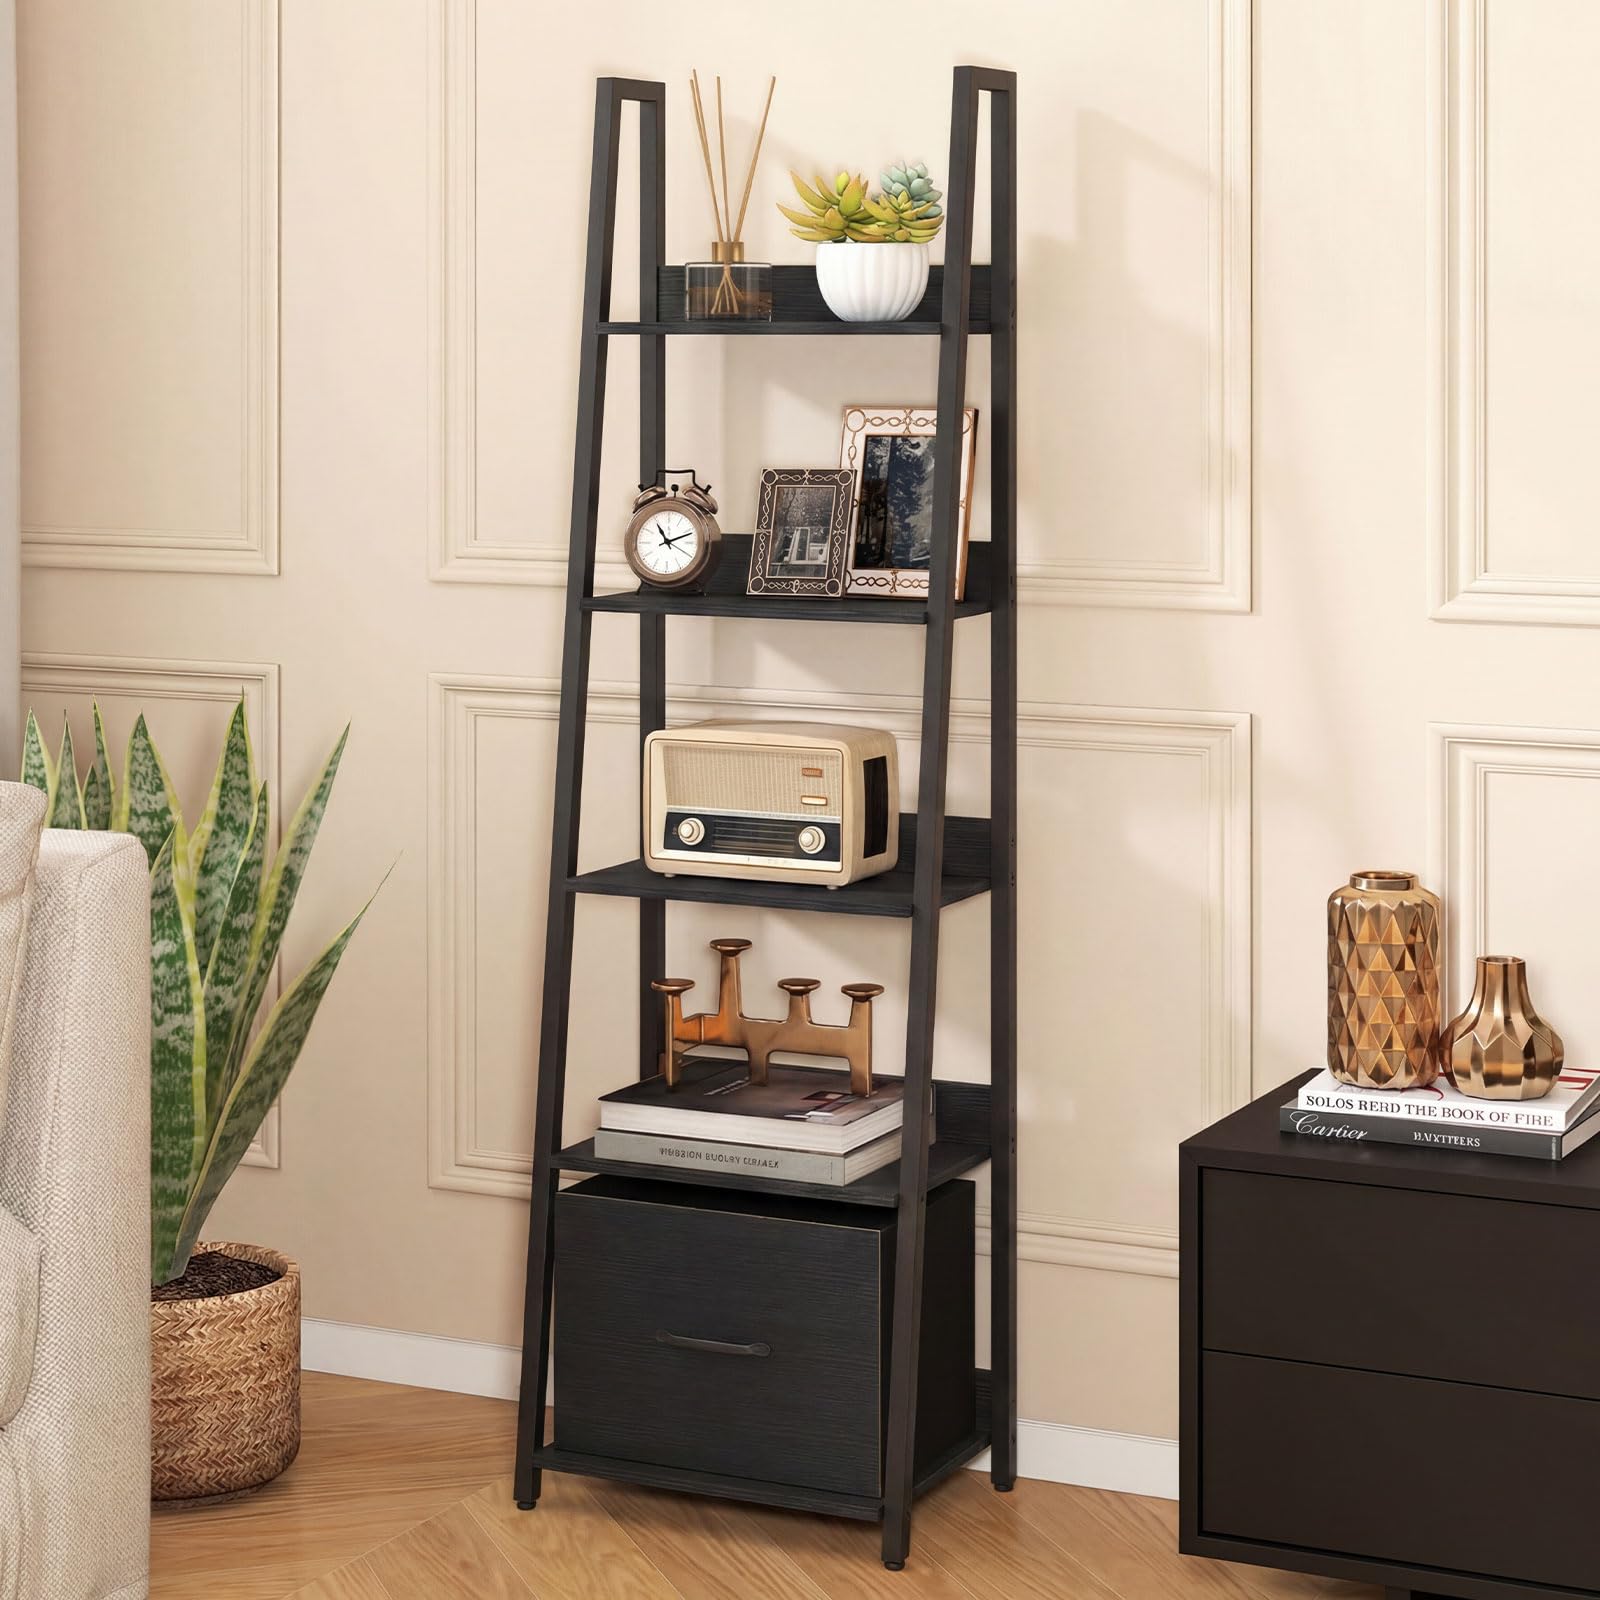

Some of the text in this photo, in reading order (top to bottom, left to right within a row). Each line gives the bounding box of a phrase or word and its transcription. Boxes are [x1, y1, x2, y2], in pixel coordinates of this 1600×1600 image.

[1289, 1110, 1368, 1140] Cartier
[1306, 1095, 1354, 1110] SOLOS
[1405, 1103, 1437, 1117] THE
[1442, 1107, 1485, 1121] BOOK
[1489, 1111, 1510, 1123] OF
[1515, 1113, 1553, 1127] FIRE
